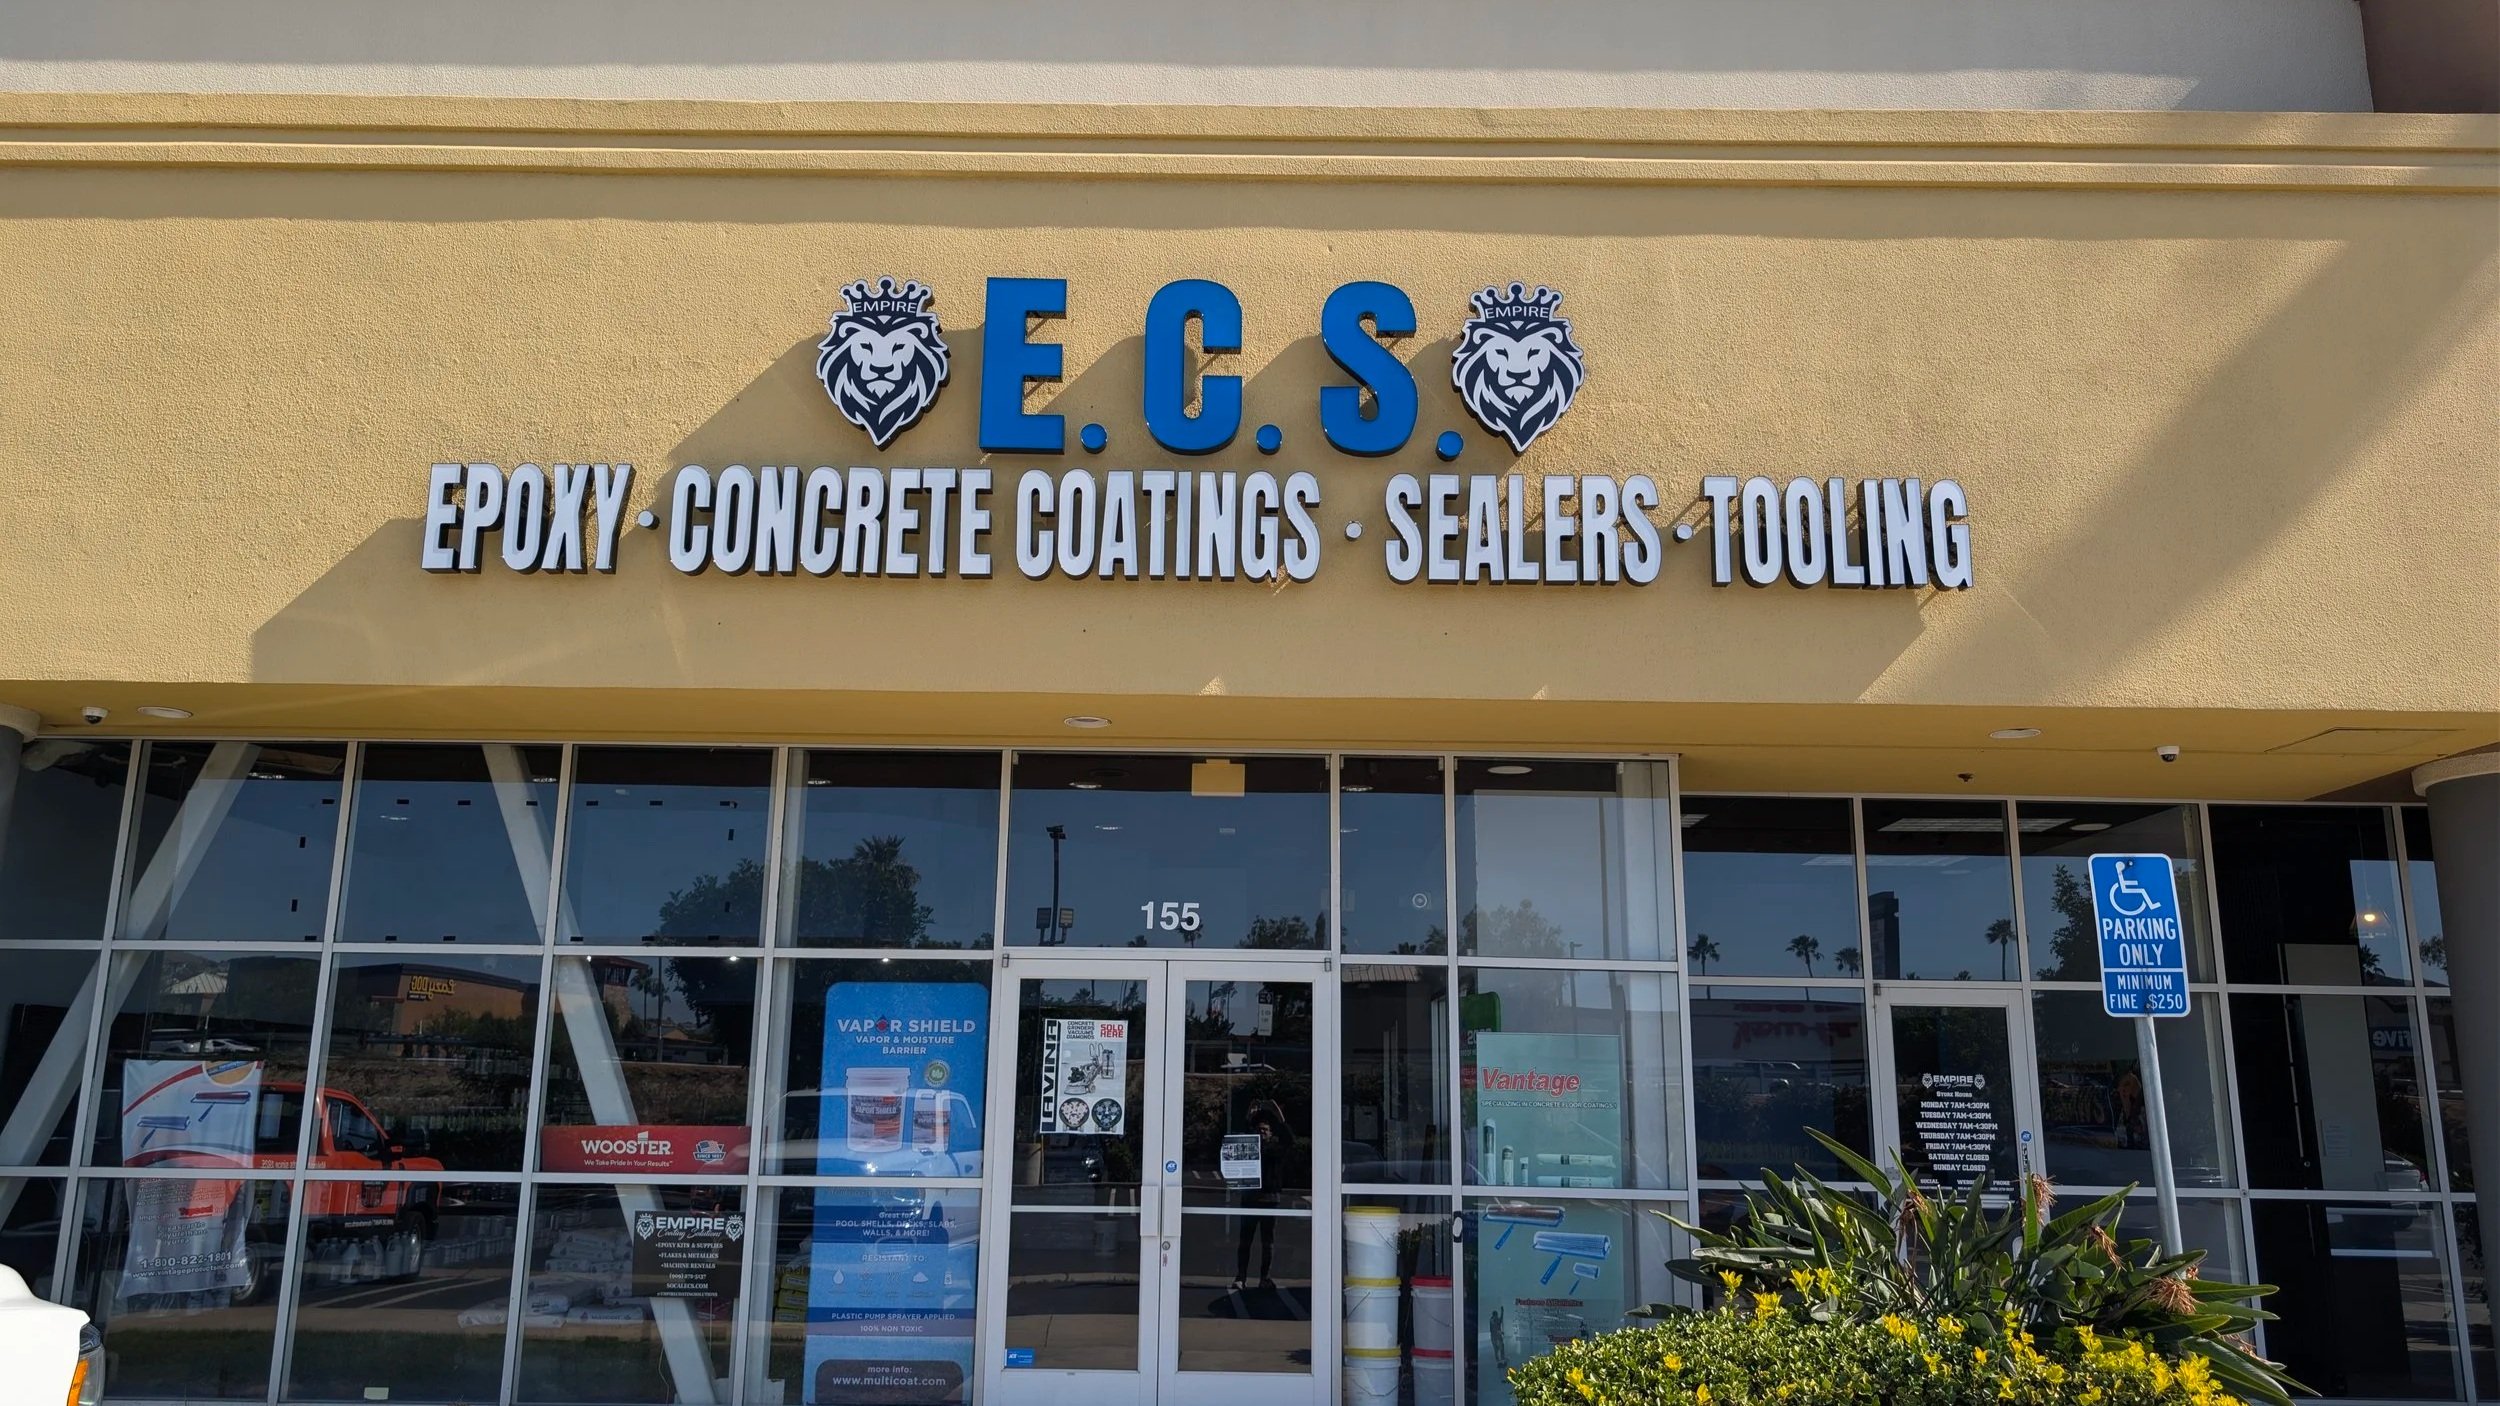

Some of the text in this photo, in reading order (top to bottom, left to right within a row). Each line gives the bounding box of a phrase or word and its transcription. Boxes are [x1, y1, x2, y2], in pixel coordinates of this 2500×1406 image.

[852, 300, 918, 314] EMPIRE
[1484, 305, 1550, 319] EMPIRE
[421, 463, 1973, 589] EPOXY CONCRETE COATINGS SEALERS TOOLING
[1141, 901, 1200, 931] 155
[2102, 917, 2176, 940] PARKING
[2119, 943, 2163, 966] ONLY
[2117, 974, 2172, 990] MINIMUM
[2109, 993, 2183, 1010] FINE $250
[837, 1017, 976, 1033] VAPOR SHIELD
[1100, 1030, 1123, 1038] HERE
[856, 1035, 955, 1044] VAPOR & MOISTURE
[882, 1046, 927, 1055] BARRIER
[1481, 1067, 1581, 1097] Vantage
[1933, 1075, 1974, 1083] EMPIRE
[1921, 1101, 1949, 1109] MONDAY
[1920, 1111, 1951, 1119] TUESDAY
[1915, 1121, 1998, 1130] WEDNESDAY 7AM-4:30PM
[1920, 1132, 1956, 1140] THURSDAY
[581, 1140, 671, 1155] WOOSTER
[1925, 1142, 1950, 1150] FRIDAY
[1928, 1153, 1964, 1161] SATURDAY
[1933, 1163, 1960, 1171] SUNDAY
[879, 1211, 899, 1219] Great
[656, 1217, 724, 1230] EMPIRE
[861, 1220, 895, 1228] SHELLS,
[657, 1228, 722, 1240] Coating Solutions
[863, 1229, 893, 1237] WALLS,
[904, 1229, 930, 1237] MORE!
[141, 1252, 232, 1269] 1-800-822-1801
[862, 1254, 909, 1262] RESISTANT
[832, 1312, 863, 1320] PLASTIC
[832, 1375, 946, 1387] www.multicoat.com
